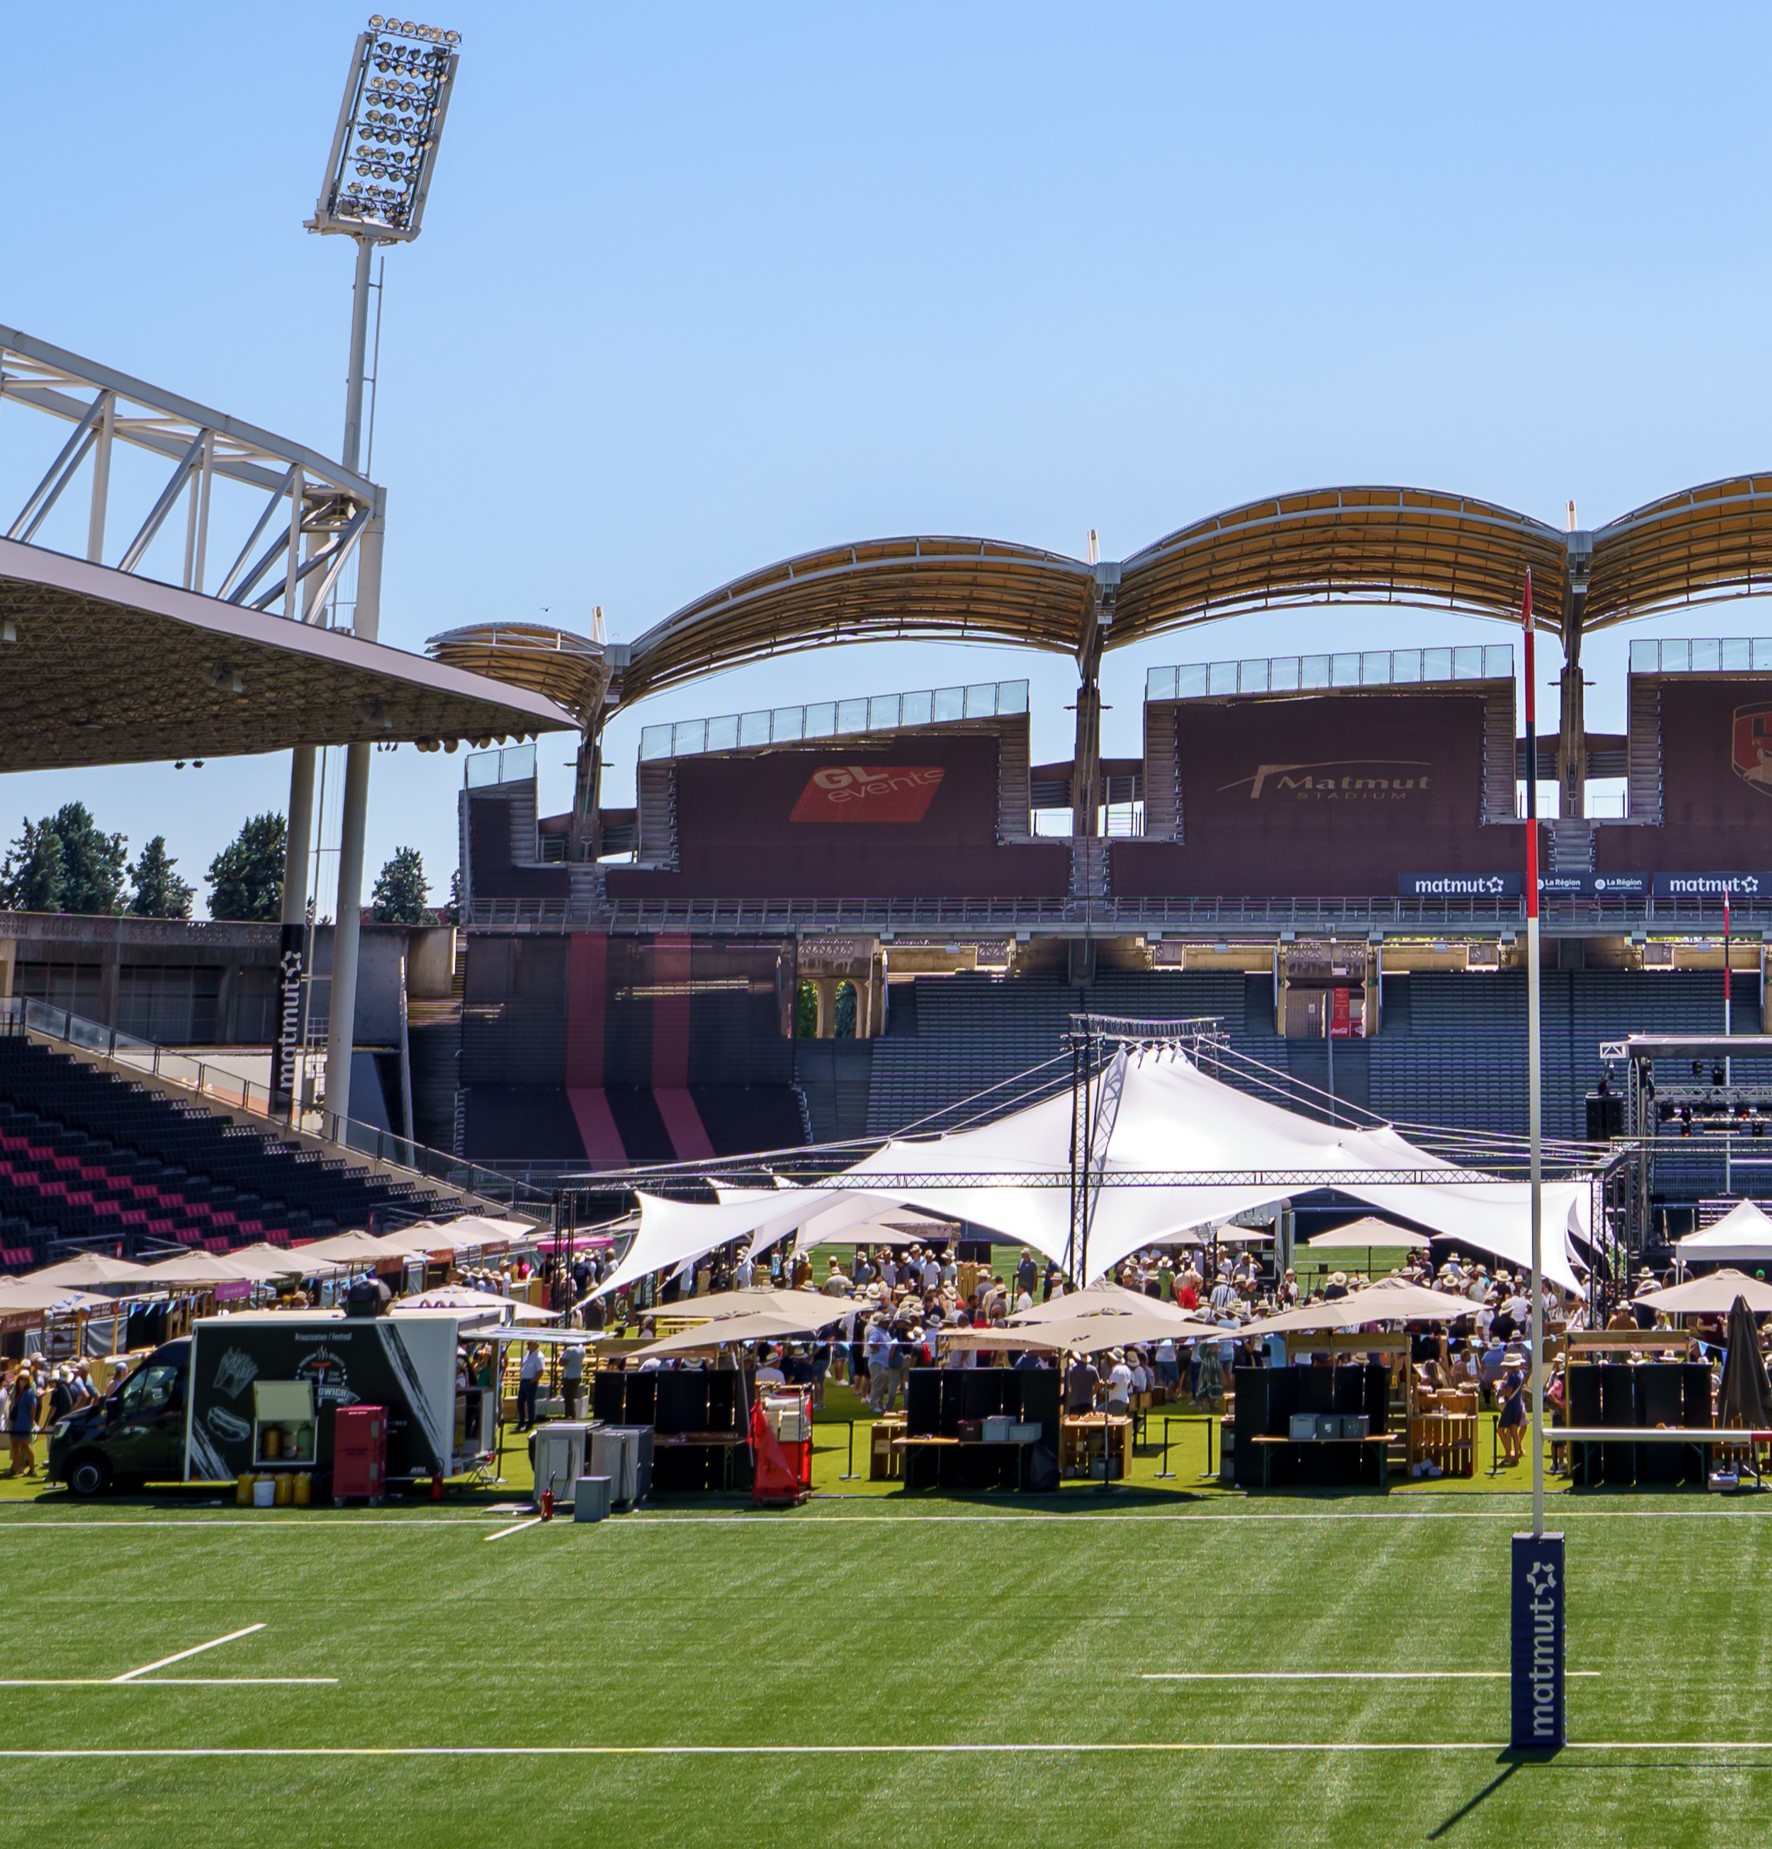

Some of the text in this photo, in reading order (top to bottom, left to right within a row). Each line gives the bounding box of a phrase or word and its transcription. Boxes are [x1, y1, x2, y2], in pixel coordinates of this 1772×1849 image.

[812, 766, 889, 789] GL
[1276, 775, 1432, 790] Matmut
[828, 769, 945, 803] events
[1296, 791, 1407, 800] STADIUM
[1415, 878, 1486, 893] matmut
[1555, 878, 1581, 887] Région
[1616, 878, 1643, 887] Région
[1670, 877, 1740, 892] matmut
[279, 978, 300, 1089] matmut
[1528, 1597, 1555, 1736] matmut
